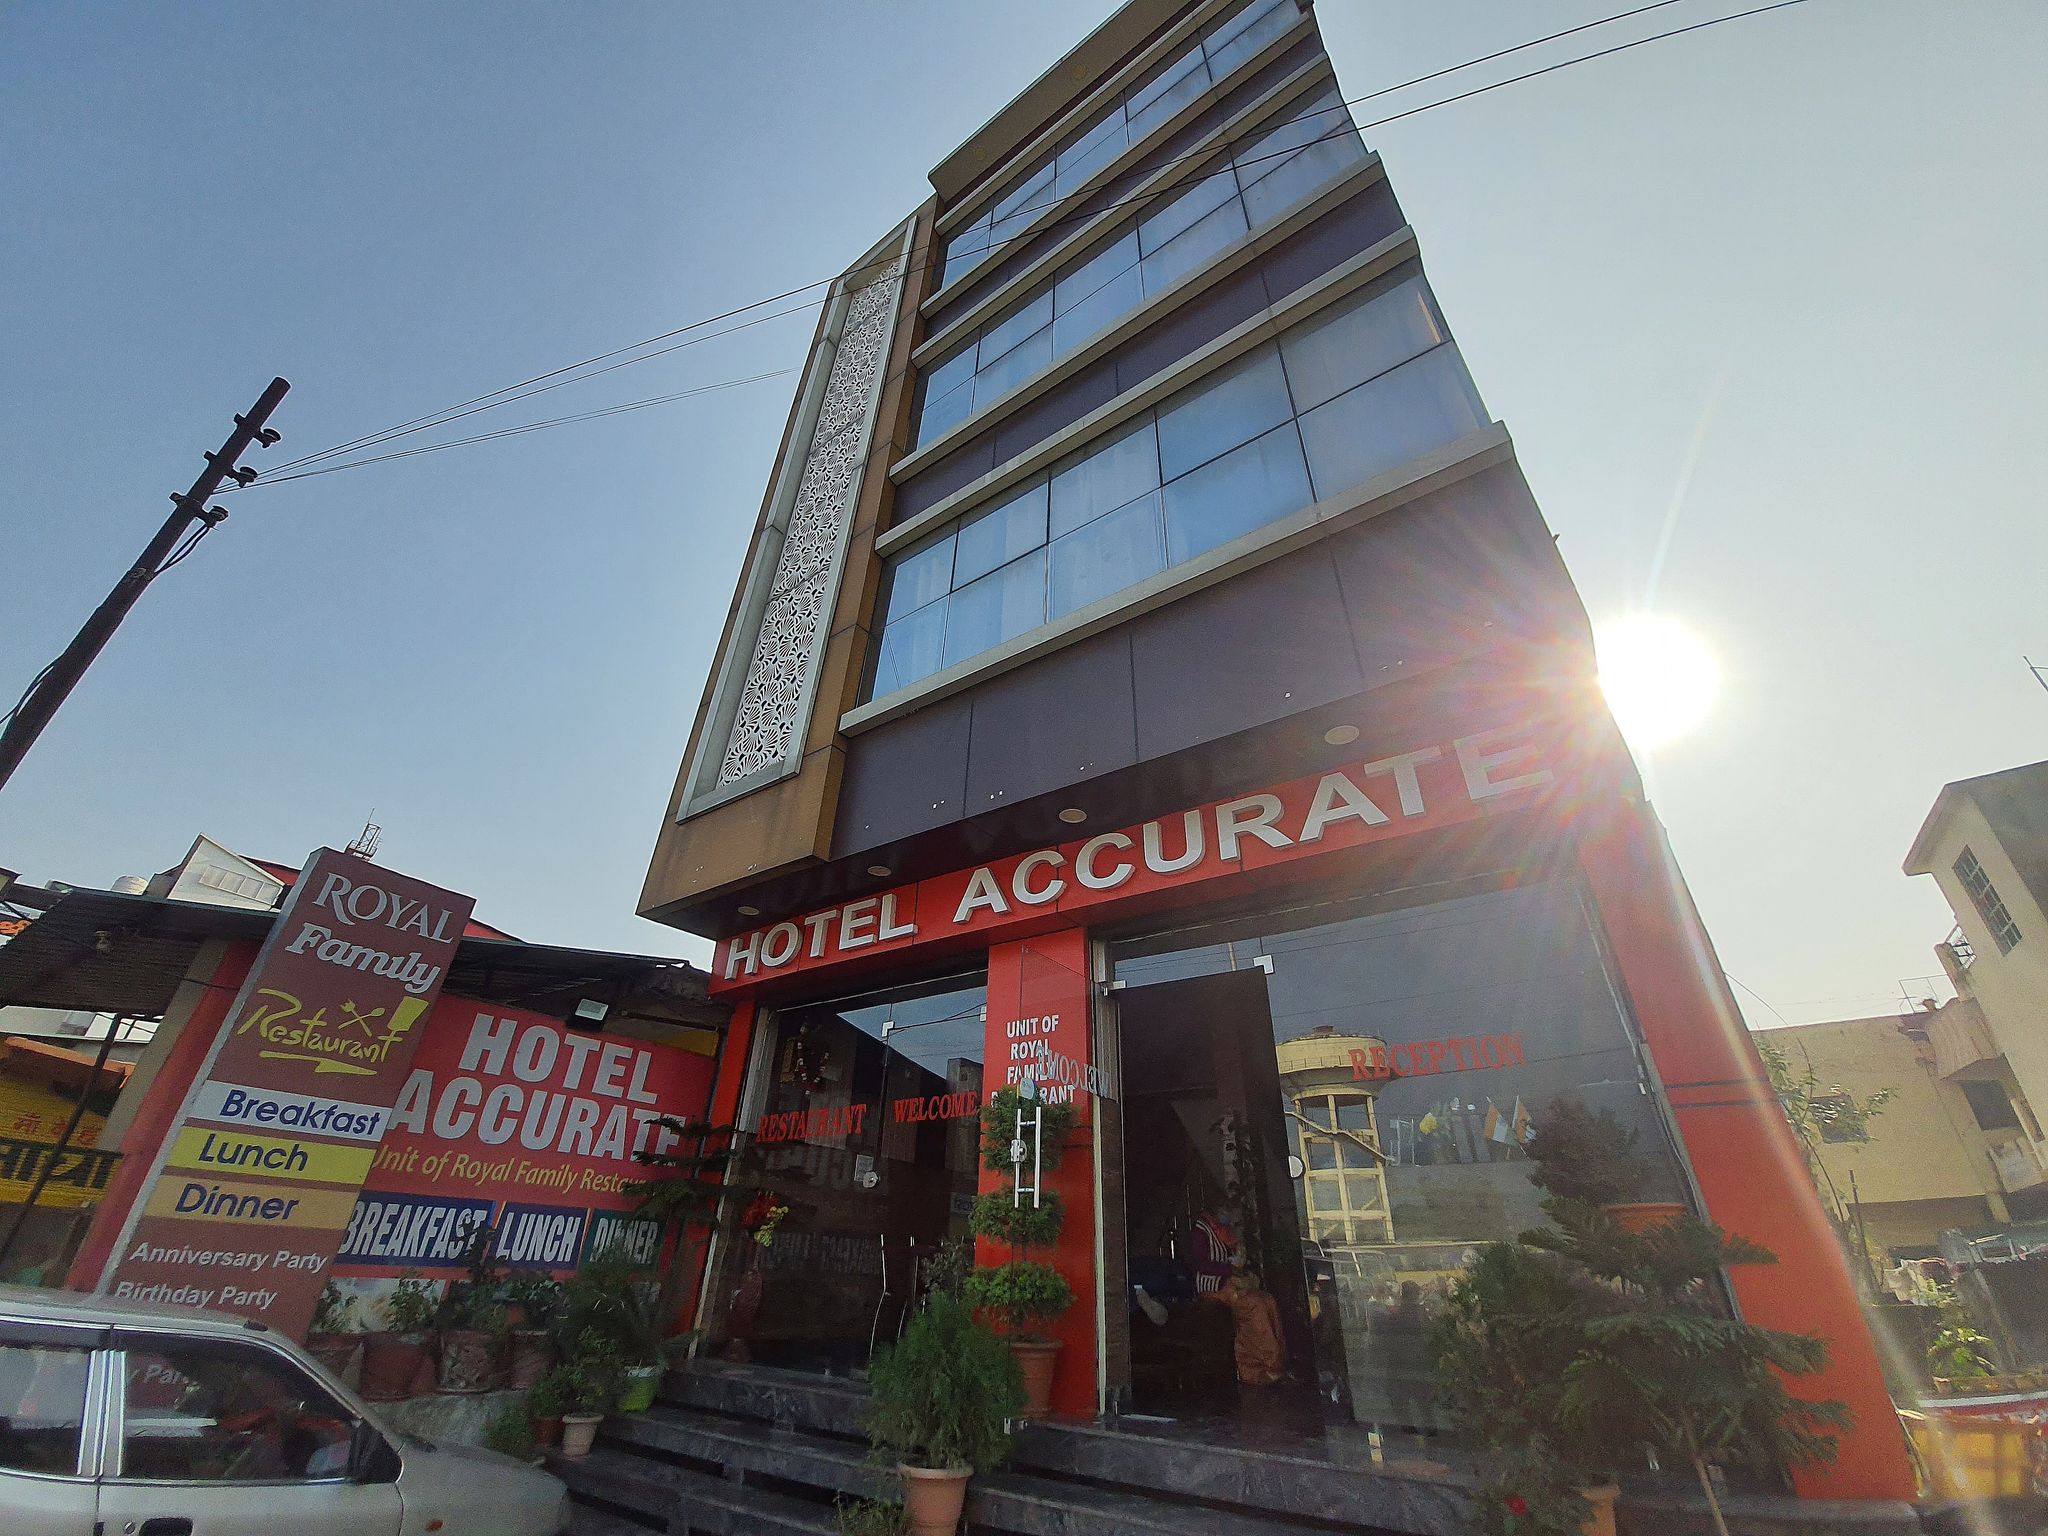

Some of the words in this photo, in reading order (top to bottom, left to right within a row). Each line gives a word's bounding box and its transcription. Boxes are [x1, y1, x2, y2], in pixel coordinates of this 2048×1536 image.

[724, 893, 919, 981] HOTEL
[952, 720, 1556, 924] ACCURATE
[312, 872, 455, 944] ROYAL
[285, 922, 441, 994] Family
[237, 988, 404, 1063] Restaurant
[1006, 1018, 1039, 1038] UNIT
[1041, 1014, 1060, 1033] OF
[458, 1012, 658, 1104] HOTEL
[1010, 1038, 1049, 1060] ROYAL
[1347, 1032, 1527, 1081] RECEPTION
[219, 1089, 381, 1136] Breakfast
[755, 1103, 868, 1143] RESTAURANT
[893, 1091, 978, 1123] WELCOME
[198, 1133, 309, 1171] Lunch
[422, 1150, 453, 1183] of
[450, 1153, 515, 1186] Royal
[514, 1160, 577, 1194] Family
[174, 1182, 300, 1221] Dinner
[337, 1200, 489, 1260] BREAKFAST
[494, 1211, 583, 1264] LUNCH
[129, 1243, 269, 1272] Anniversary
[271, 1250, 330, 1274] Party
[114, 1281, 216, 1307] Birthday
[218, 1286, 279, 1311] Party
